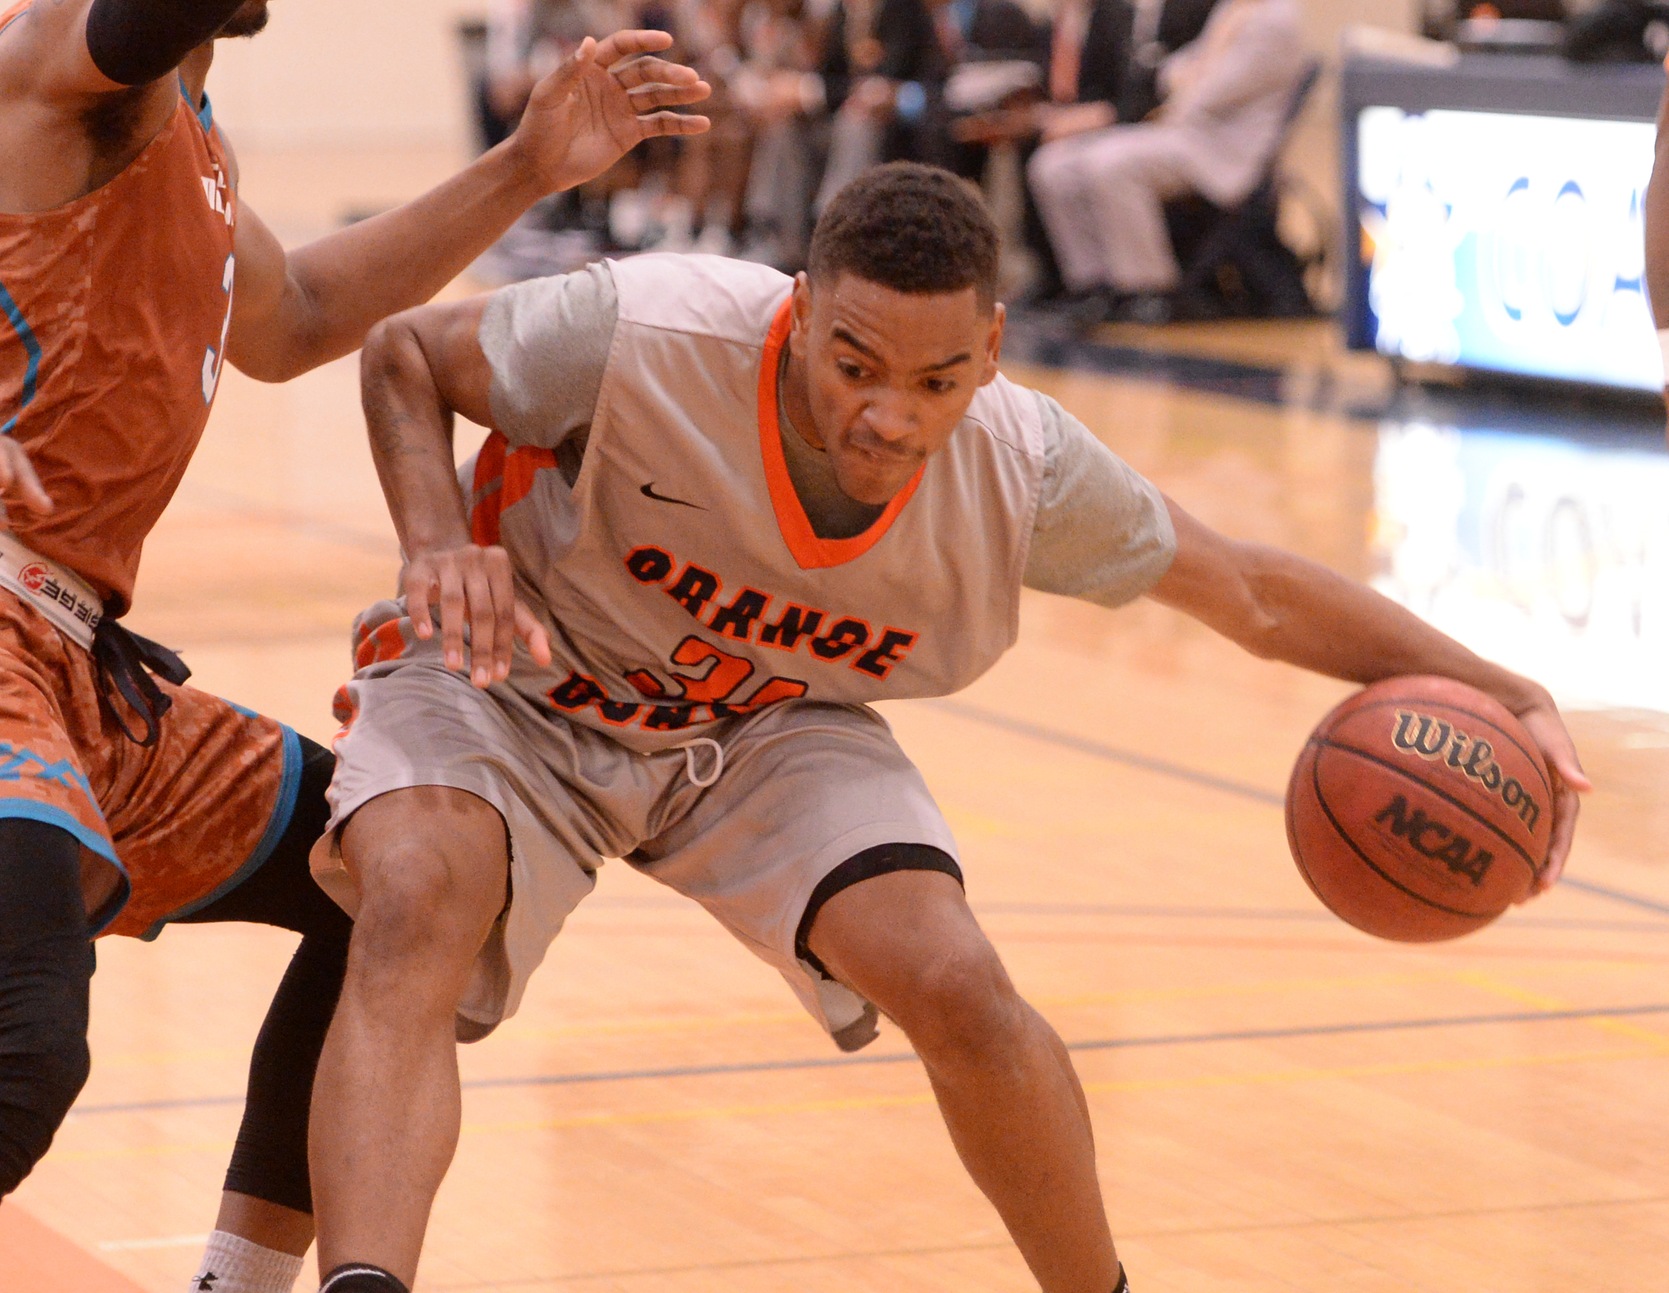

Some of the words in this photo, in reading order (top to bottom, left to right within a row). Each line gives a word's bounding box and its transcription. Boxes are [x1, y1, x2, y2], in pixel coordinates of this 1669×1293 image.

[624, 545, 920, 681] ORANGE
[1391, 708, 1541, 836] Wilson
[1375, 793, 1495, 887] NCAA
